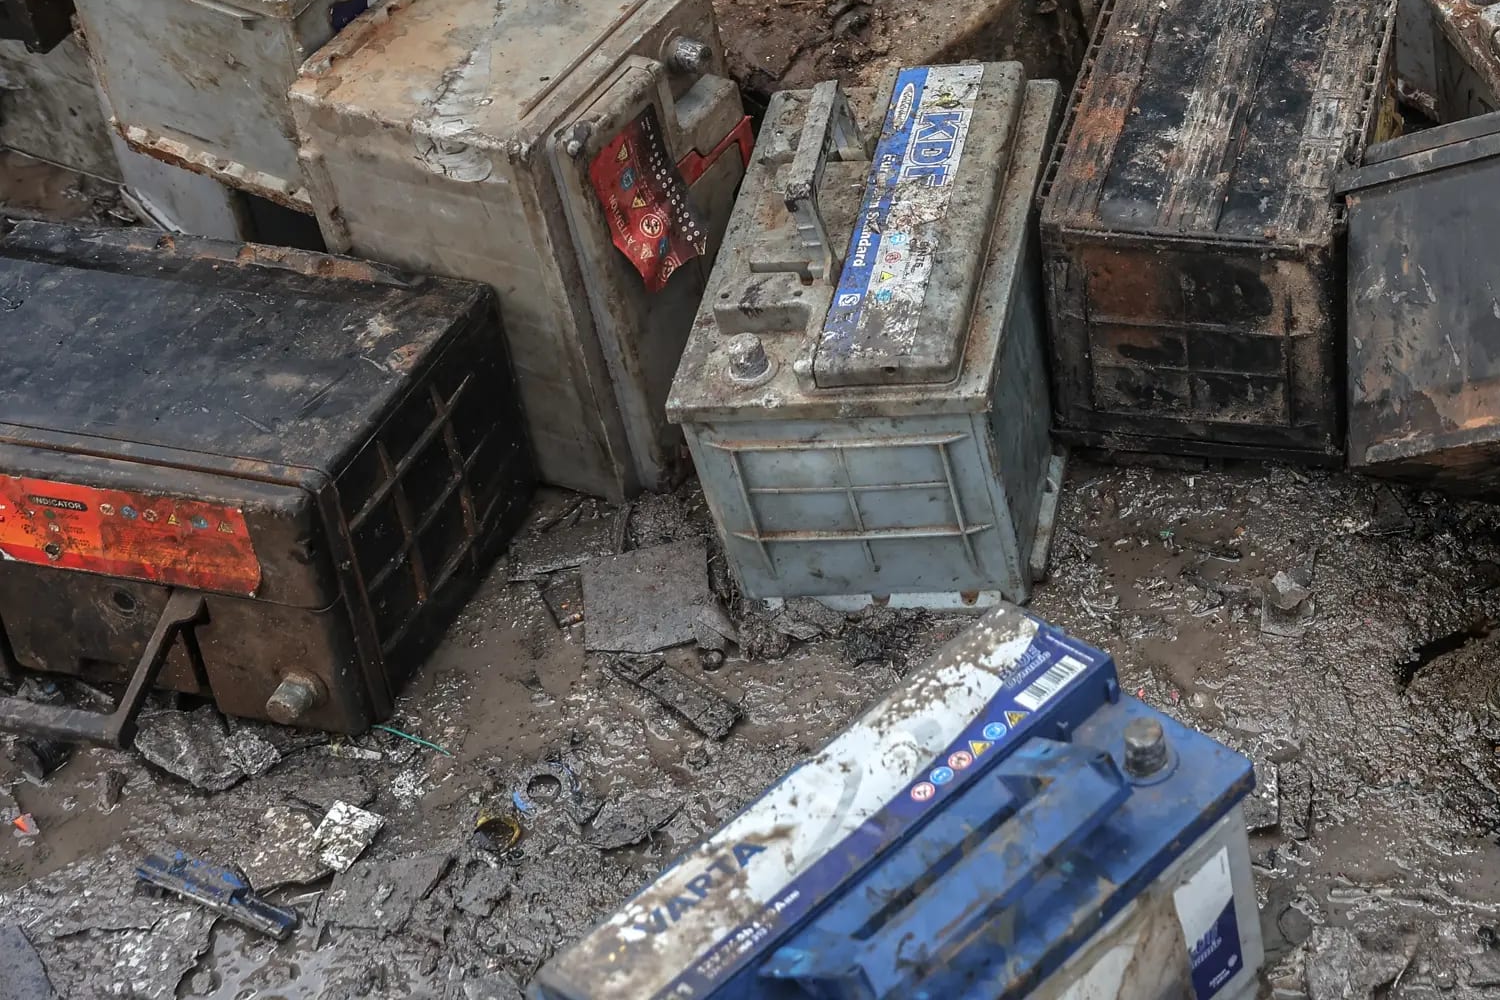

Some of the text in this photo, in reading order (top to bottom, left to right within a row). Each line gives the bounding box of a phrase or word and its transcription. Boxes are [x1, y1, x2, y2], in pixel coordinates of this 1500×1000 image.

[904, 111, 964, 188] KDF
[608, 194, 637, 247] ATTENTION
[852, 212, 879, 268] Sandard
[633, 838, 766, 936] VARTA
